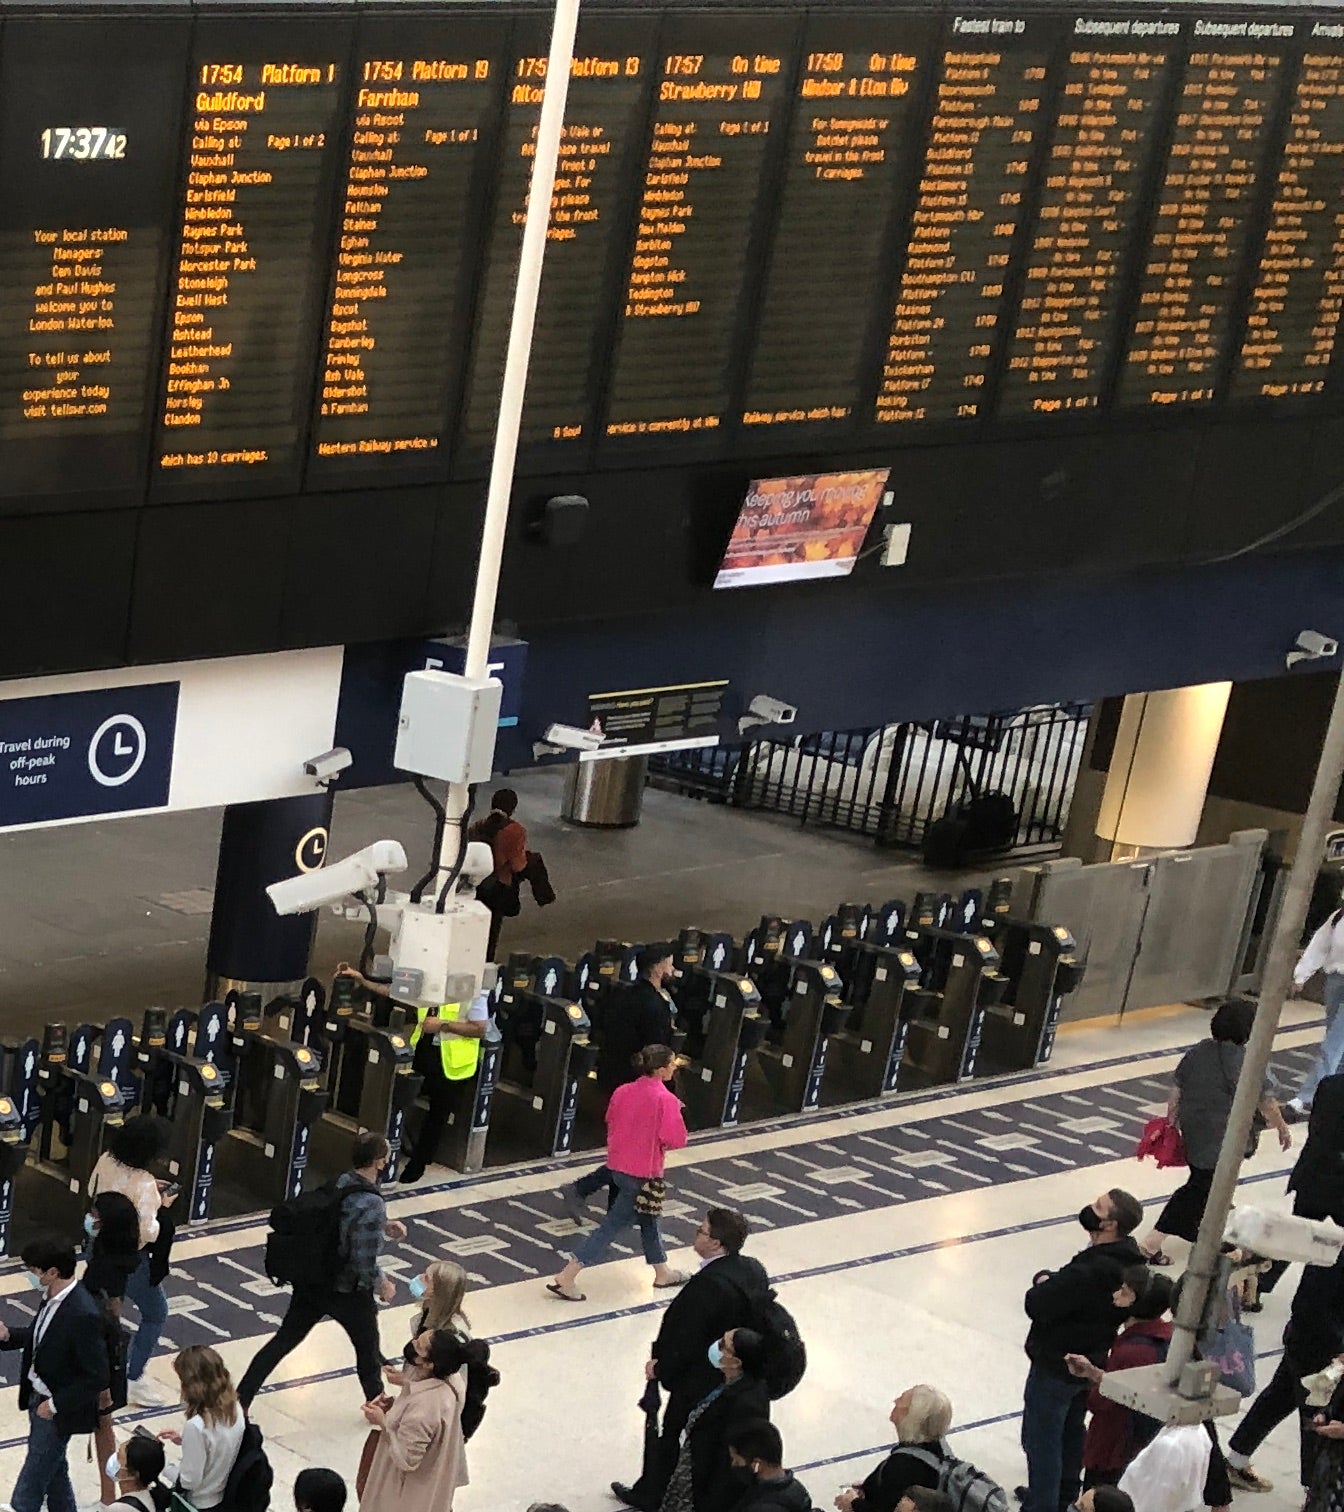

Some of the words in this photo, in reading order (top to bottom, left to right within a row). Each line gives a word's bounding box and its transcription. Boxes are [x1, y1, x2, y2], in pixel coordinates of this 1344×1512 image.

[1074, 17, 1131, 36] Subsequent
[1132, 20, 1179, 36] departures
[1194, 19, 1247, 36] Subsequent
[1248, 22, 1294, 37] departures
[363, 60, 403, 82] 17:54
[411, 60, 469, 81] Platform
[474, 59, 489, 79] 19
[664, 54, 704, 75] 17:57
[731, 55, 749, 74] On
[868, 52, 887, 72] On
[201, 64, 244, 86] 17:54
[261, 63, 322, 85] Platform
[327, 63, 335, 83] 1
[357, 87, 420, 109] Farnham
[659, 80, 739, 102] Strawberry
[195, 90, 265, 113] Guildford
[164, 412, 201, 426] Clandon
[33, 735, 70, 749] during
[9, 753, 56, 770] off-peak
[15, 774, 47, 787] hours
